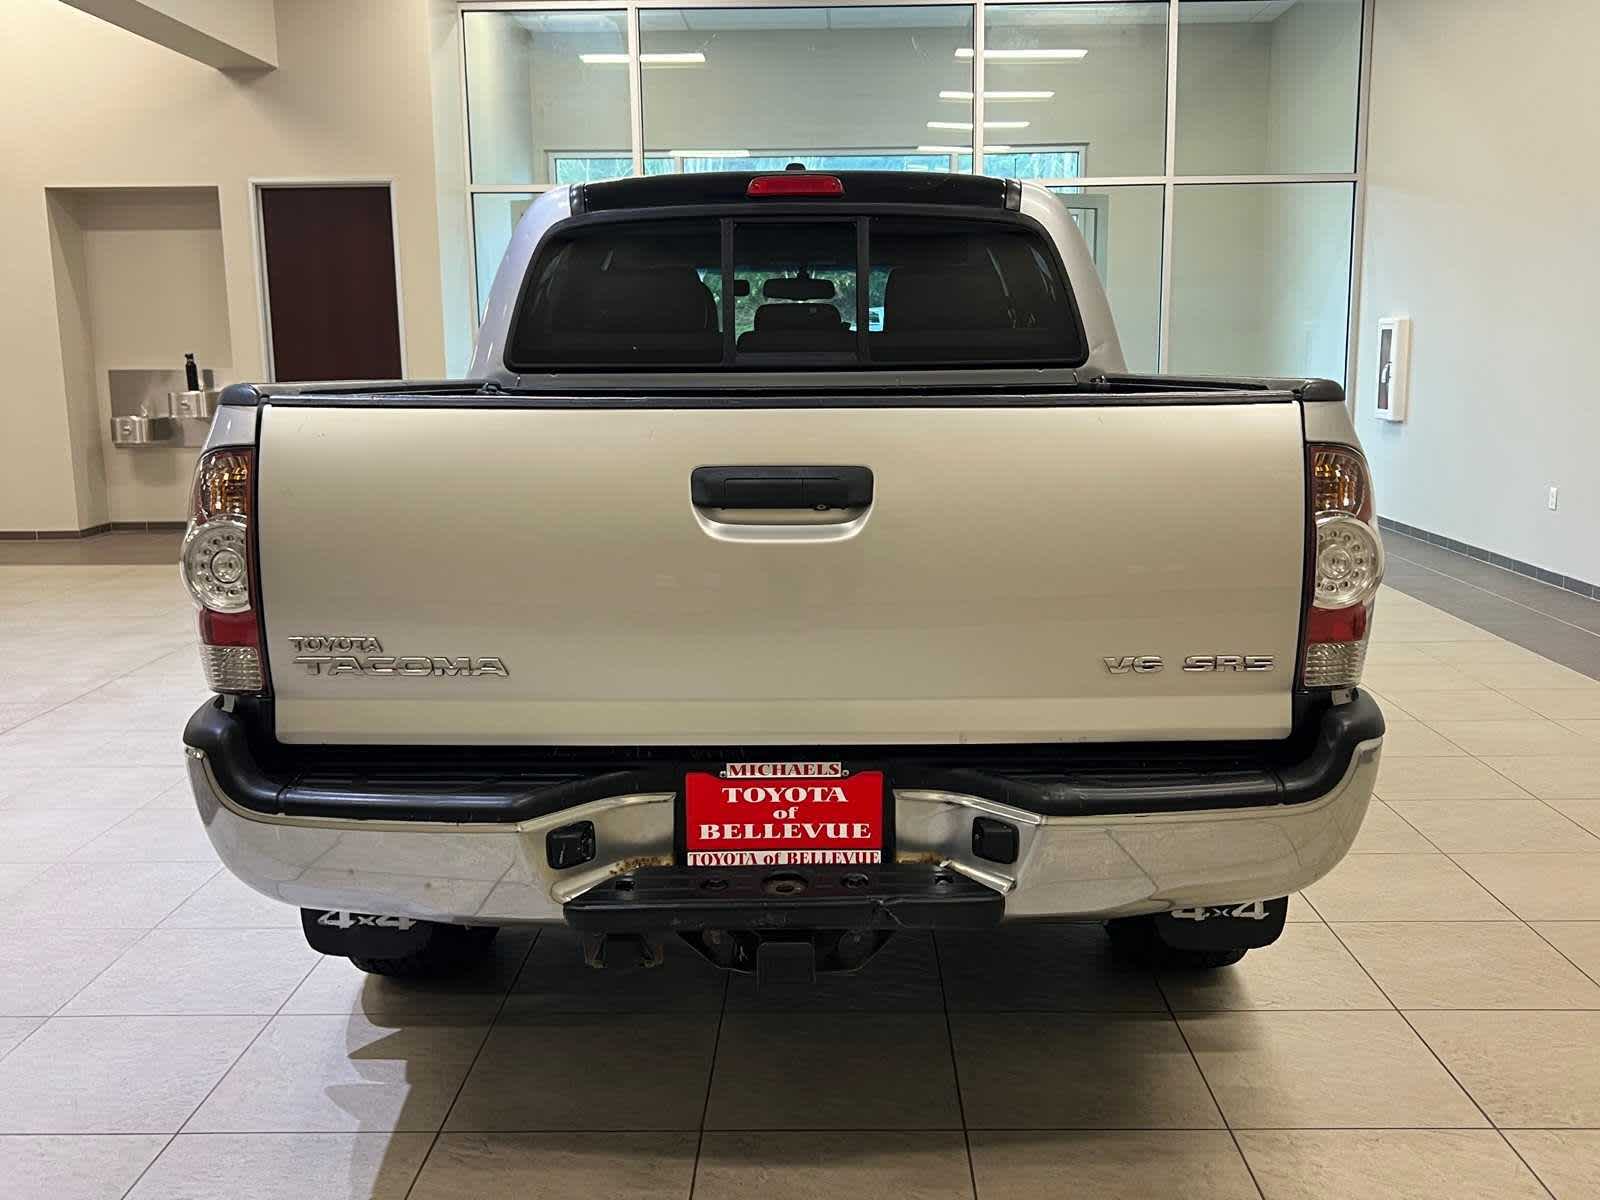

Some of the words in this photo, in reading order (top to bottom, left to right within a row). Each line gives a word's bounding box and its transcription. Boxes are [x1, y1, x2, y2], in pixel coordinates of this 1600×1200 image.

[288, 636, 383, 653] TOYOTA
[293, 656, 509, 677] TACOMA
[1103, 655, 1164, 674] V6
[1183, 655, 1276, 673] SR5
[729, 763, 840, 776] MICHAELS
[721, 787, 848, 803] TOYOTA
[772, 806, 799, 819] of
[699, 823, 871, 840] BELLEVUE
[689, 852, 758, 866] TOYOTA
[763, 852, 781, 865] of
[787, 851, 880, 865] BELLEVUE
